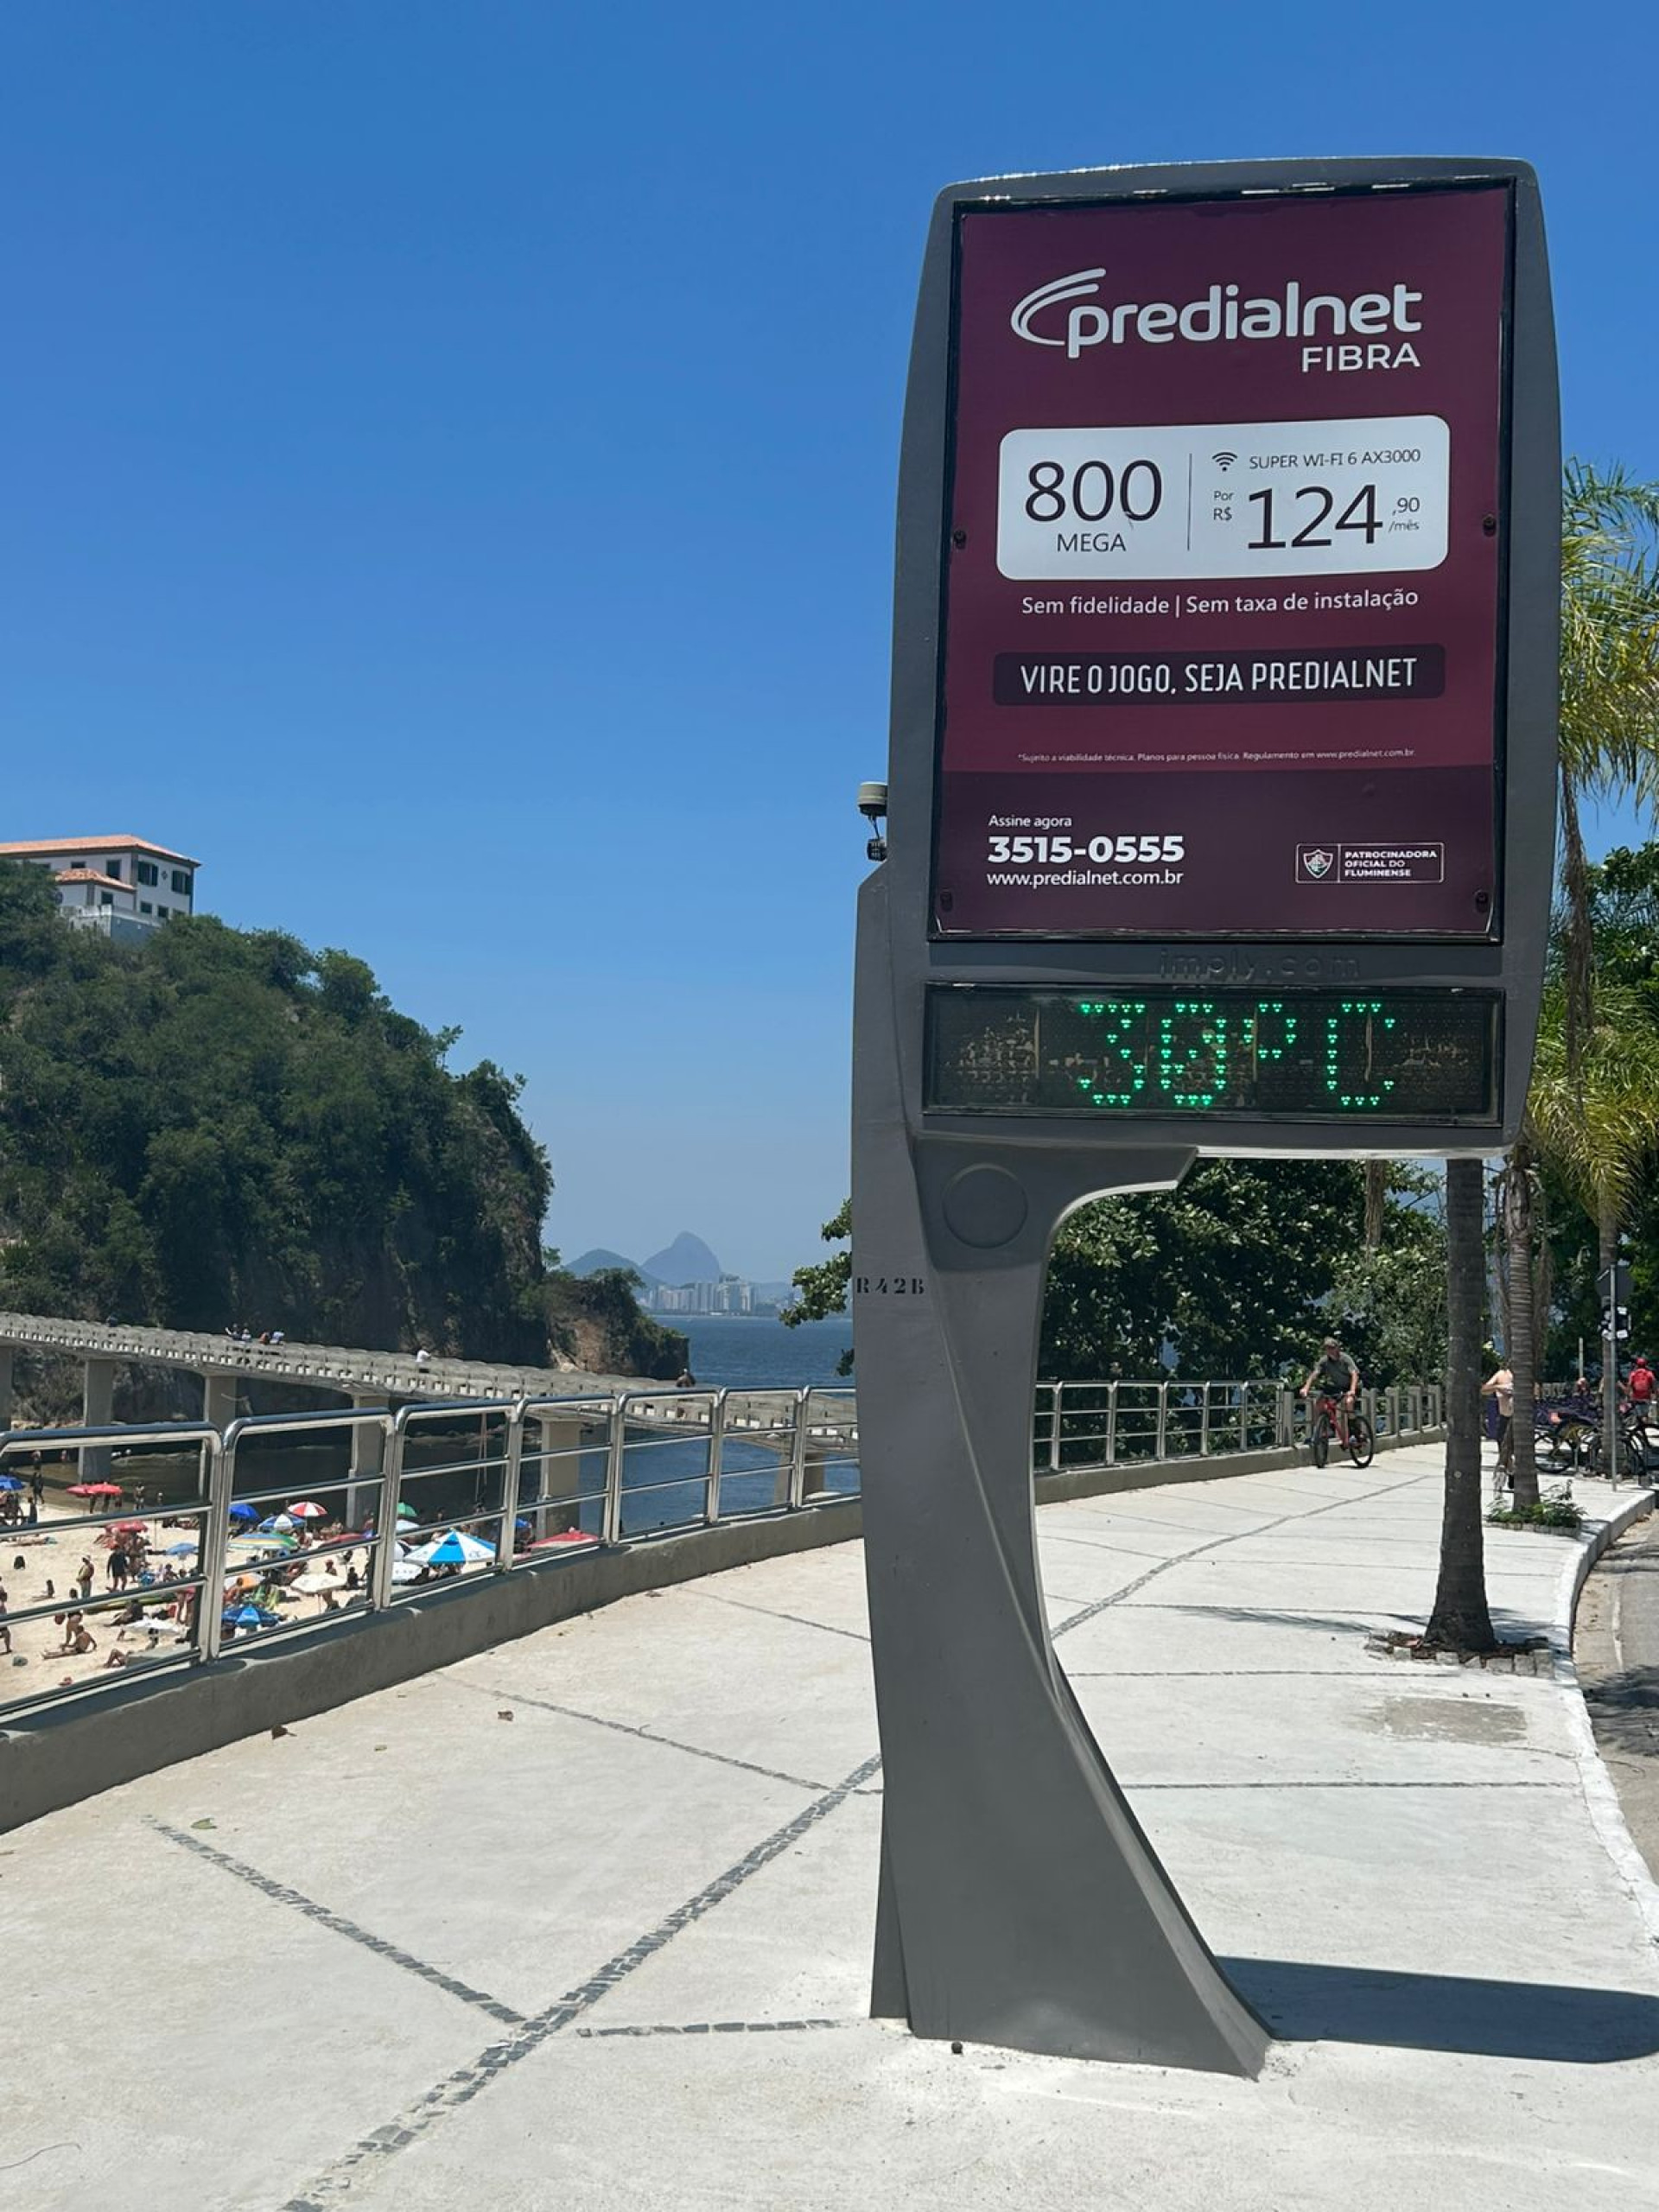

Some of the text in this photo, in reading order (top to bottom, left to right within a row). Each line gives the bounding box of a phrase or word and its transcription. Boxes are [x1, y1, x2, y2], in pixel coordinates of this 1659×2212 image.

[1067, 281, 1423, 359] predialnet
[1301, 342, 1421, 373] FIBRA
[1249, 448, 1421, 469] SUPER WI-FI 6 AX3000
[1025, 460, 1162, 522] 800
[1213, 490, 1234, 501] Por
[1213, 506, 1233, 521] R$
[1249, 485, 1383, 550] 124
[1056, 532, 1127, 552] MEGA
[1021, 597, 1064, 614] Sem
[1070, 595, 1169, 614] fidelidade
[1185, 595, 1229, 613] Sem
[1235, 596, 1277, 613] taxa
[1283, 593, 1308, 611] de
[1314, 588, 1419, 612] instalação
[1020, 658, 1418, 695] VIRE O JOGO, SEJA PREDIALNET
[1137, 753, 1165, 762] Planos
[1243, 751, 1298, 761] Regulamento
[988, 816, 1072, 830] Assine agora
[988, 836, 1185, 863] 3515-0555
[1344, 850, 1437, 859] PATROCINADORA
[987, 869, 1184, 889] www.predialnet.com.br
[1160, 950, 1360, 980] imply.com
